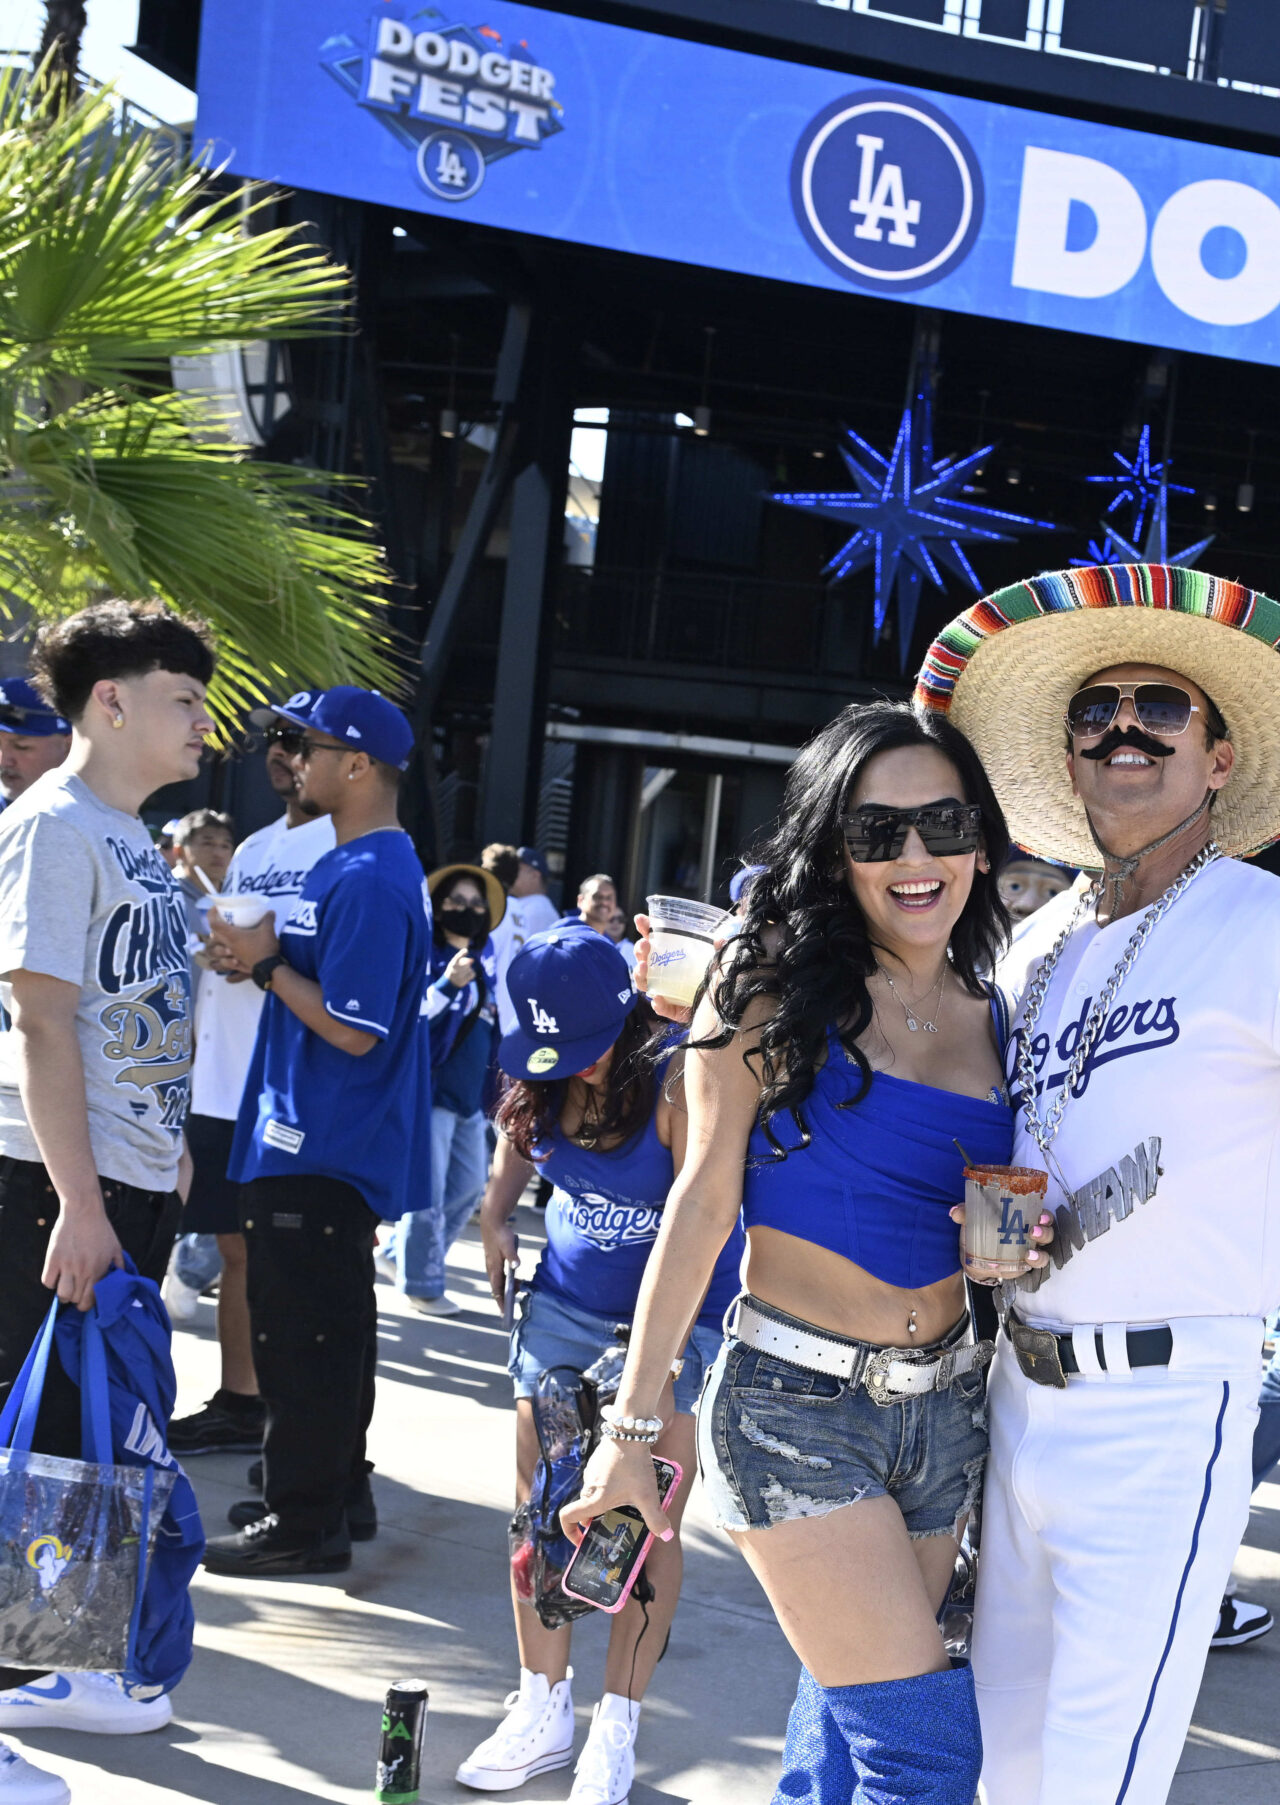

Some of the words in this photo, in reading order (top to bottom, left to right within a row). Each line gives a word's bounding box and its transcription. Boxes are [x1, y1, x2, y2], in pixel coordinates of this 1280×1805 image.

[376, 17, 555, 100] DODGER
[366, 57, 548, 141] FEST
[436, 141, 467, 188] LA
[850, 134, 921, 248] LA
[221, 863, 307, 897] odger
[97, 894, 189, 996] CHAMP
[650, 948, 687, 967] Dodgers
[527, 998, 560, 1033] LA
[997, 1197, 1029, 1244] LA
[381, 1713, 413, 1741] PA
